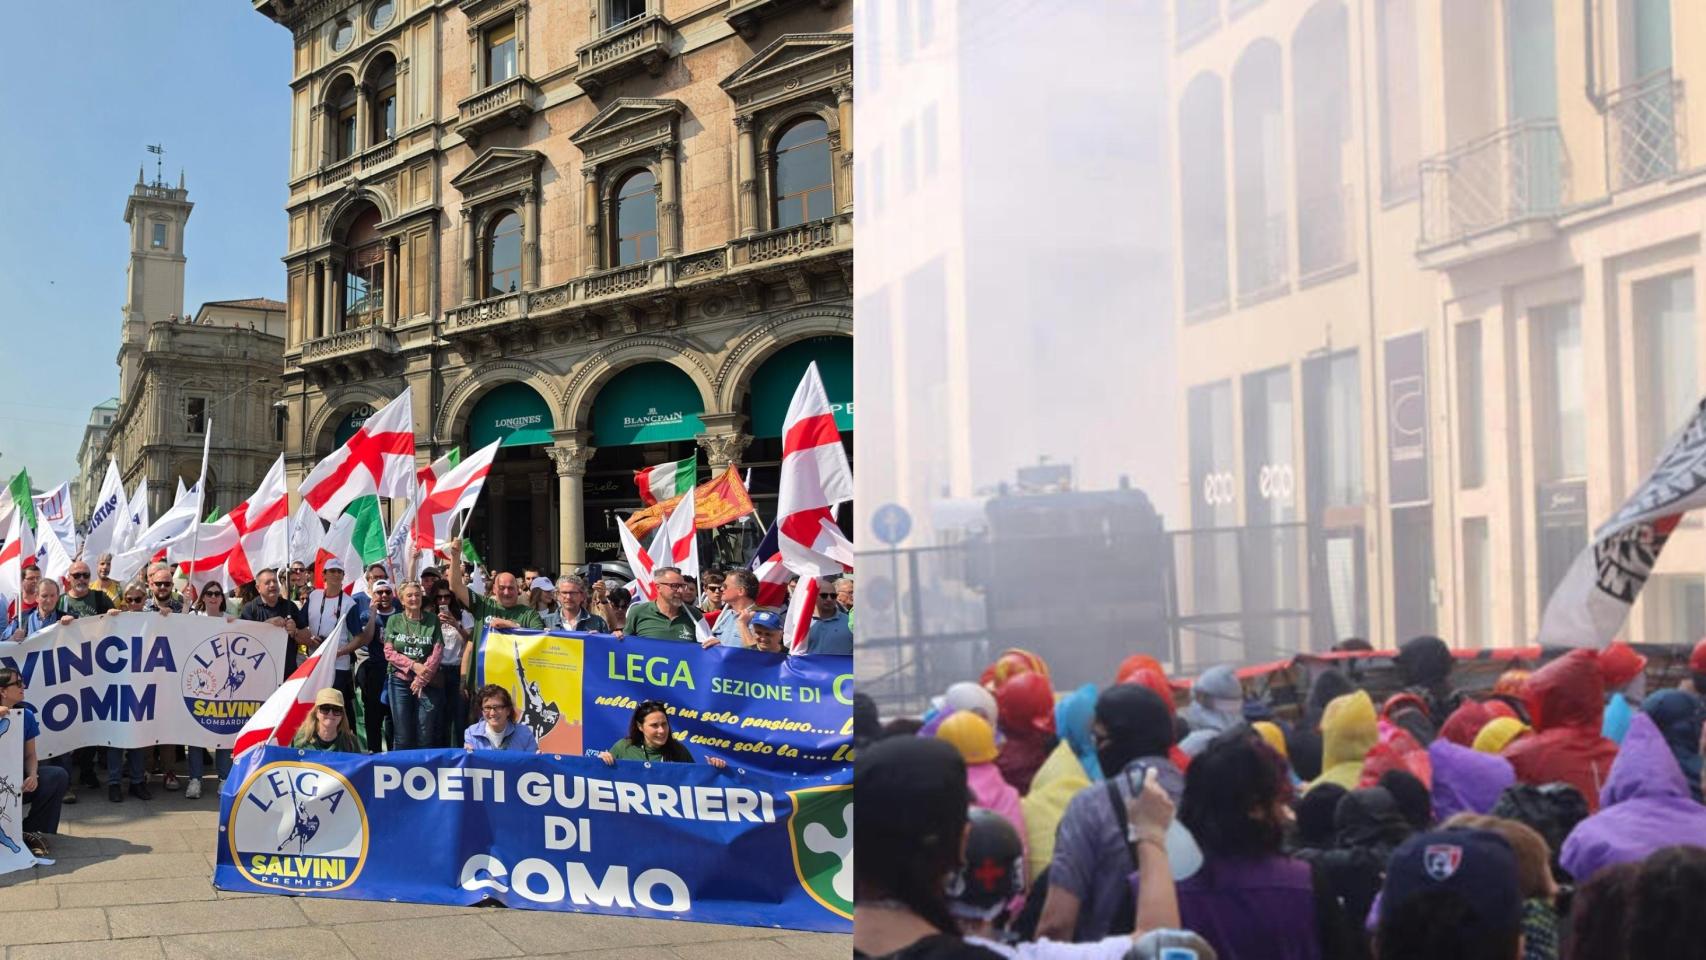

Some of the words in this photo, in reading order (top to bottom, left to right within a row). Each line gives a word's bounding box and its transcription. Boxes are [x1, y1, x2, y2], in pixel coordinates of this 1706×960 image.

[495, 415, 542, 428] LONGINES
[624, 411, 683, 425] BLANCPAIN
[1, 636, 177, 689] VINCIA
[194, 636, 266, 670] LEGA
[608, 651, 695, 690] LEGA
[711, 677, 792, 702] SEZIONE
[800, 686, 820, 704] DI
[13, 683, 157, 732] OMM
[594, 695, 638, 710] nella
[678, 708, 698, 719] un
[700, 711, 739, 725] solo
[690, 735, 731, 748] cuore
[733, 741, 773, 755] solo
[777, 744, 799, 758] la
[248, 771, 345, 815] LEGA
[374, 766, 505, 803] POETI
[517, 771, 776, 823] GUERRIERI
[544, 815, 591, 853] DI
[250, 854, 346, 880] SALVINI
[261, 876, 335, 887] PREMIER
[460, 853, 692, 913] COMO
